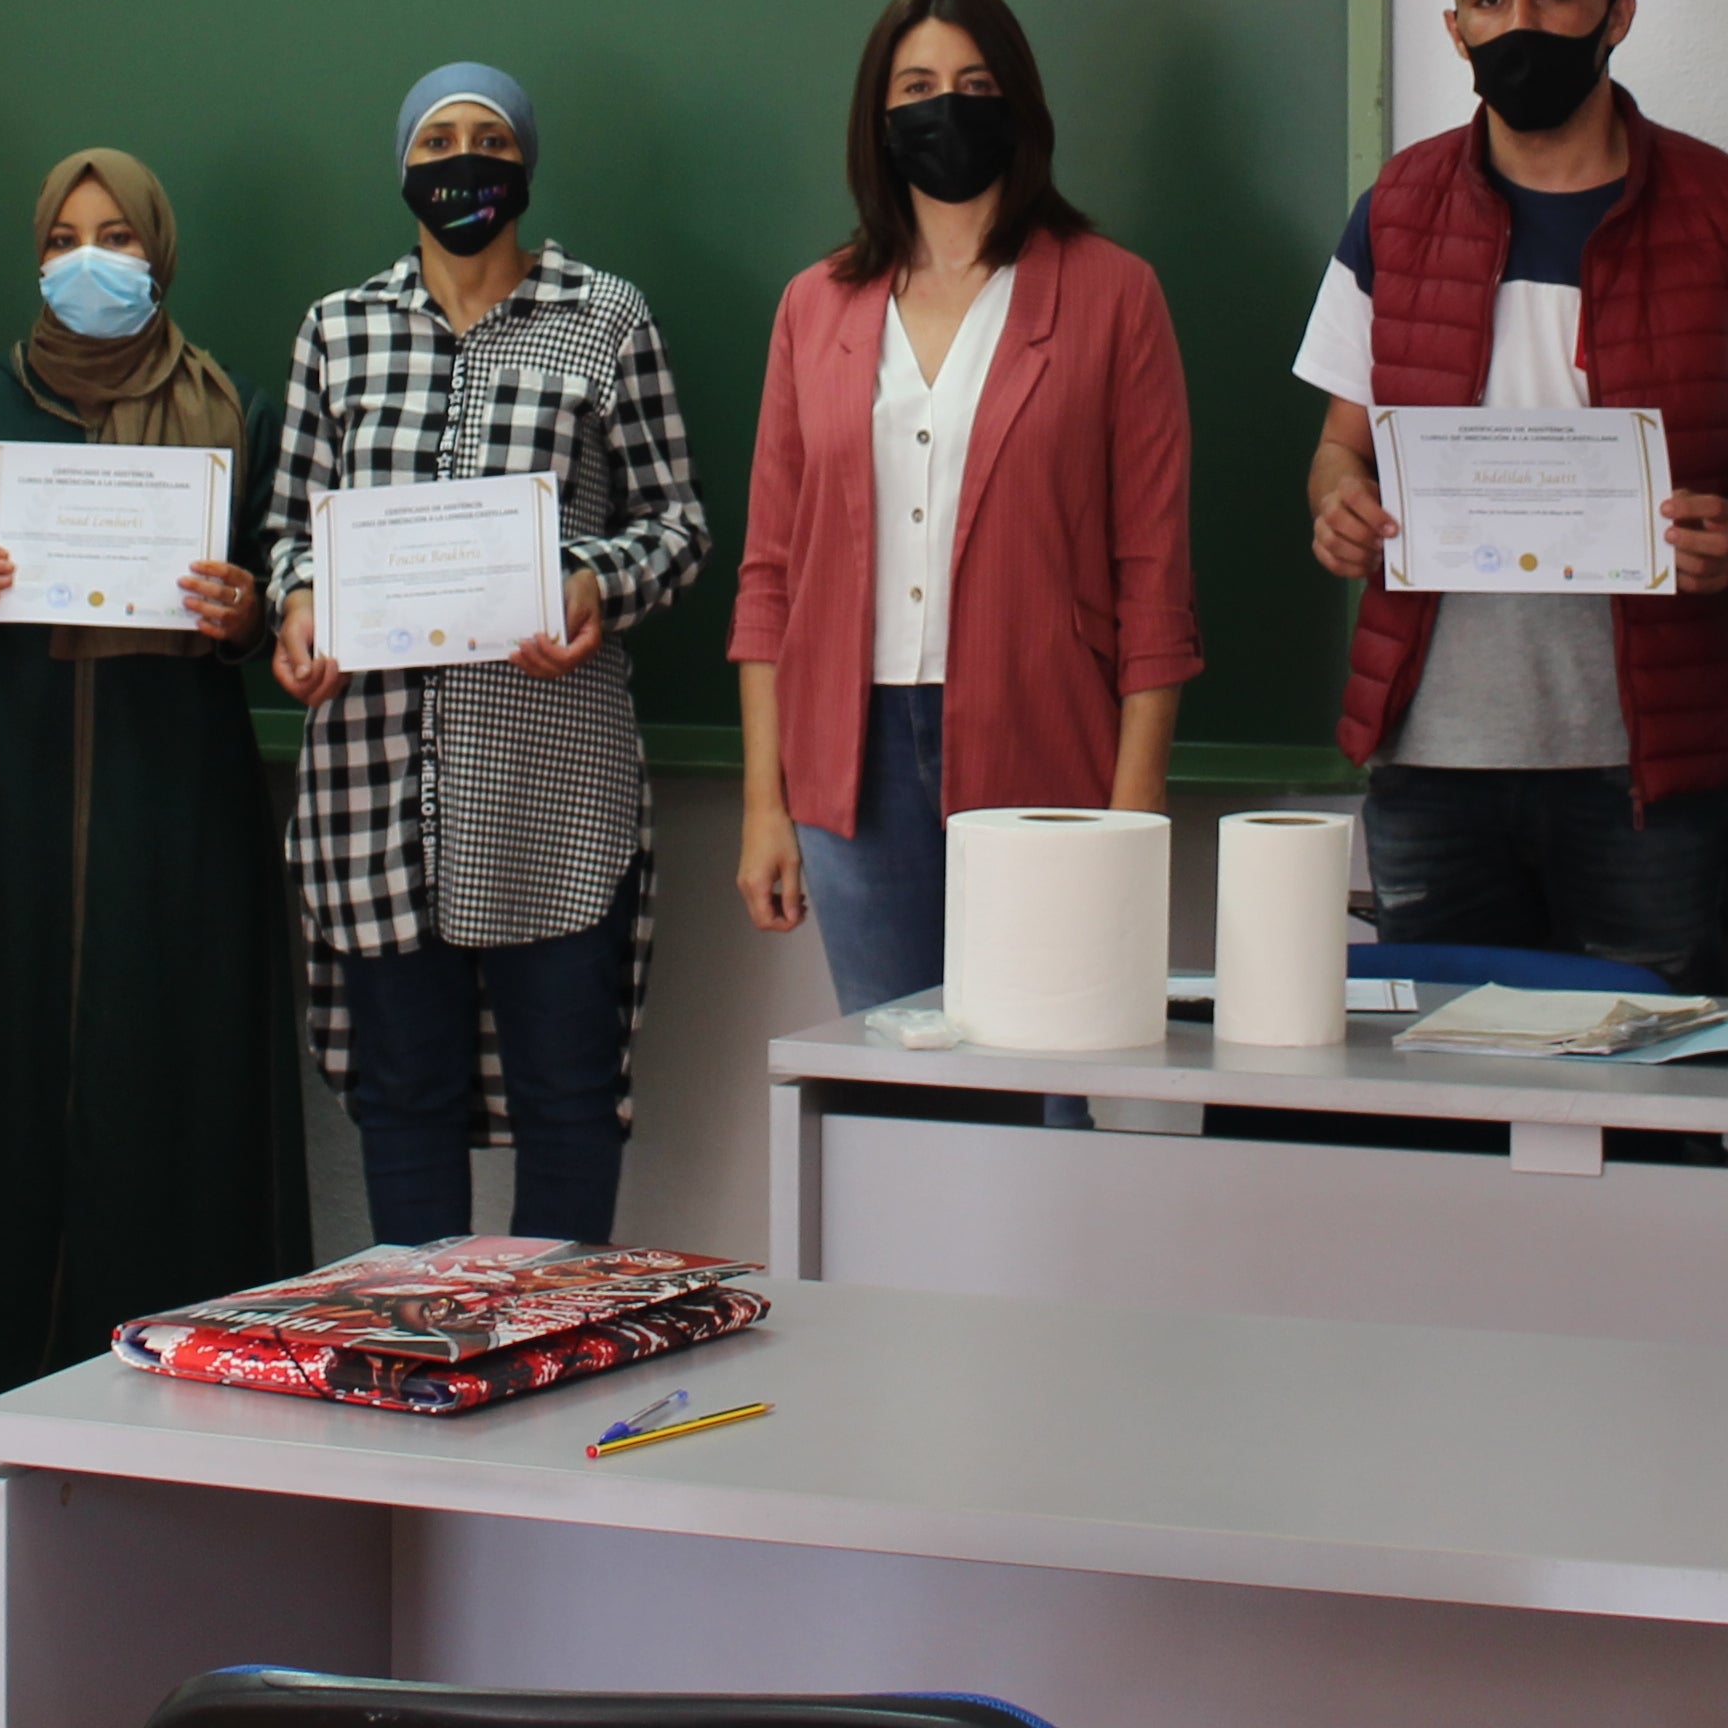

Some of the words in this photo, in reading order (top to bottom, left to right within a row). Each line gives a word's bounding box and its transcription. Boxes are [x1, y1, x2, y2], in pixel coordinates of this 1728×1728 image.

[420, 689, 436, 740] SHINE
[420, 760, 436, 816] HELLO
[422, 835, 437, 887] SHINE
[188, 1308, 339, 1333] YAMAHA
